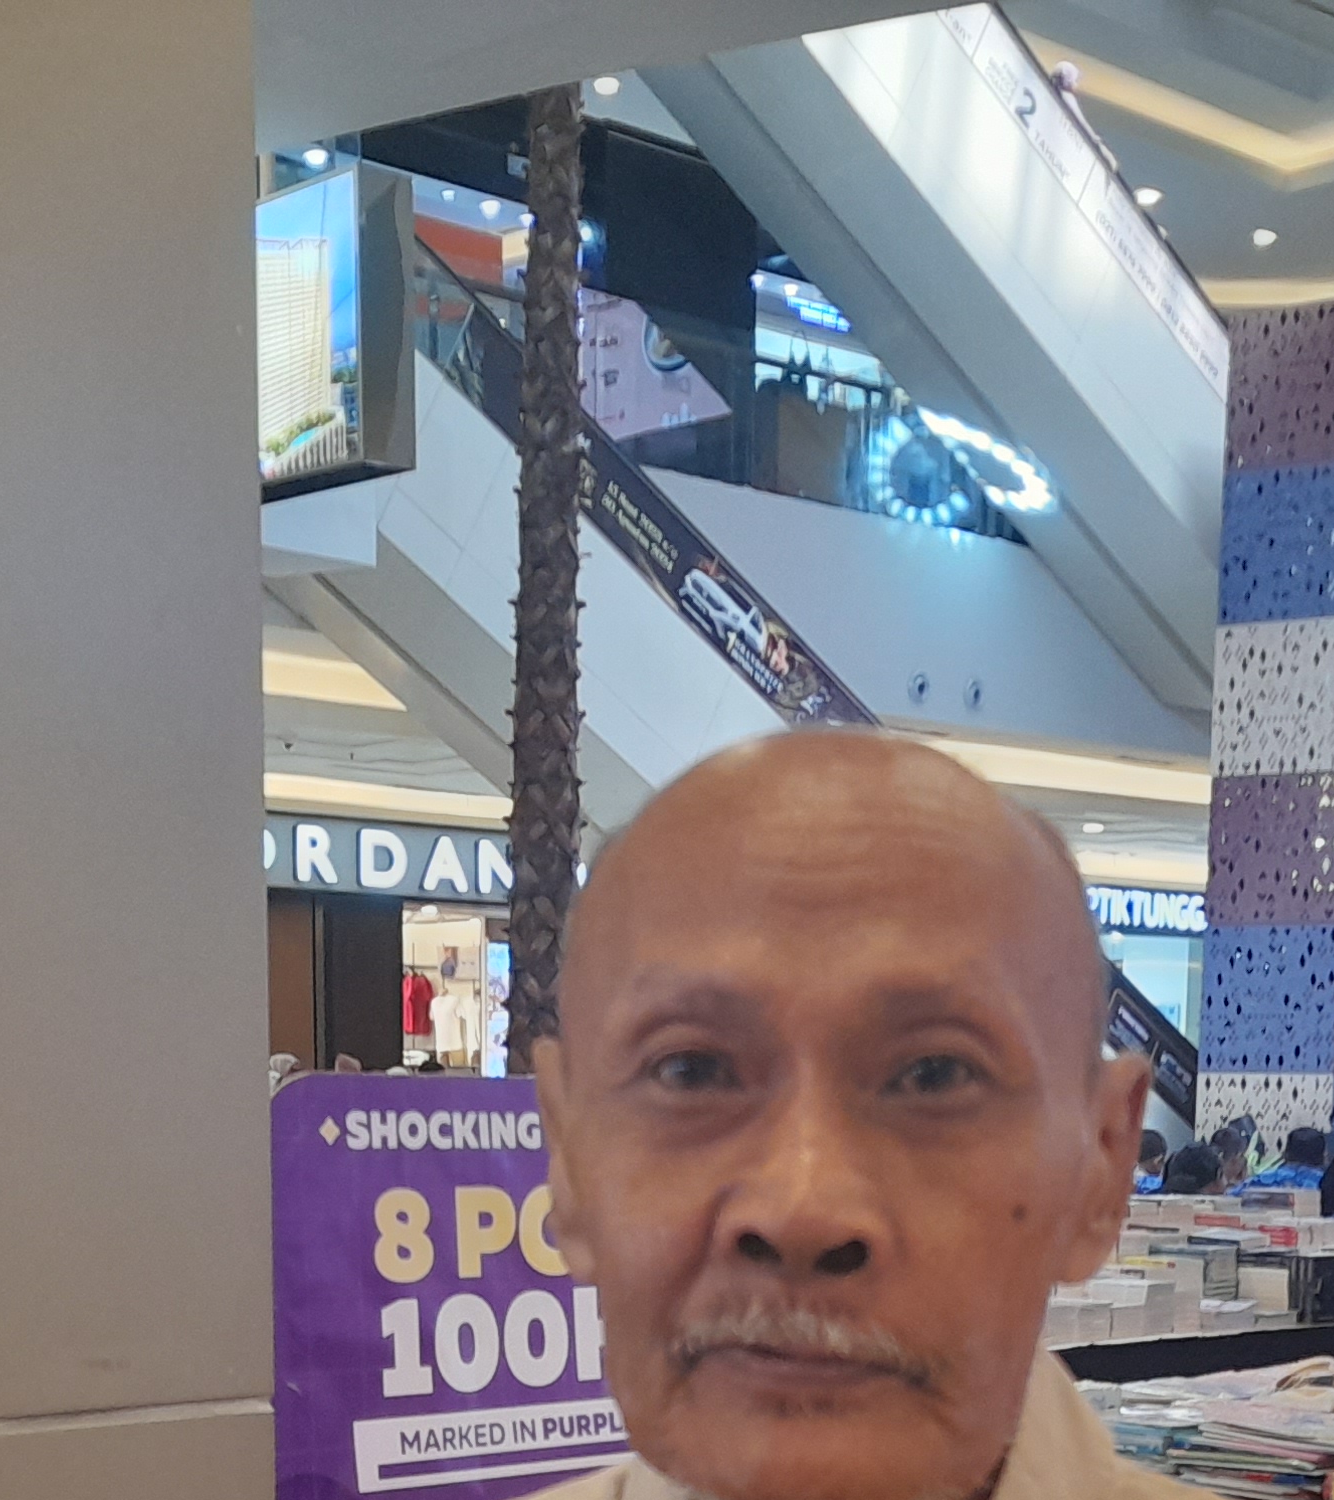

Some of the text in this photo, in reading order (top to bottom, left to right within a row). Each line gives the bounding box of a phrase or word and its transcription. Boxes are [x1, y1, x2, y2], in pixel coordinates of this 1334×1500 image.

[1015, 86, 1037, 129] 2
[264, 823, 513, 894] RDAN
[344, 1109, 542, 1151] SHOCKING
[373, 1187, 435, 1283] 8
[400, 1420, 506, 1456] MARKED
[512, 1417, 537, 1445] IN
